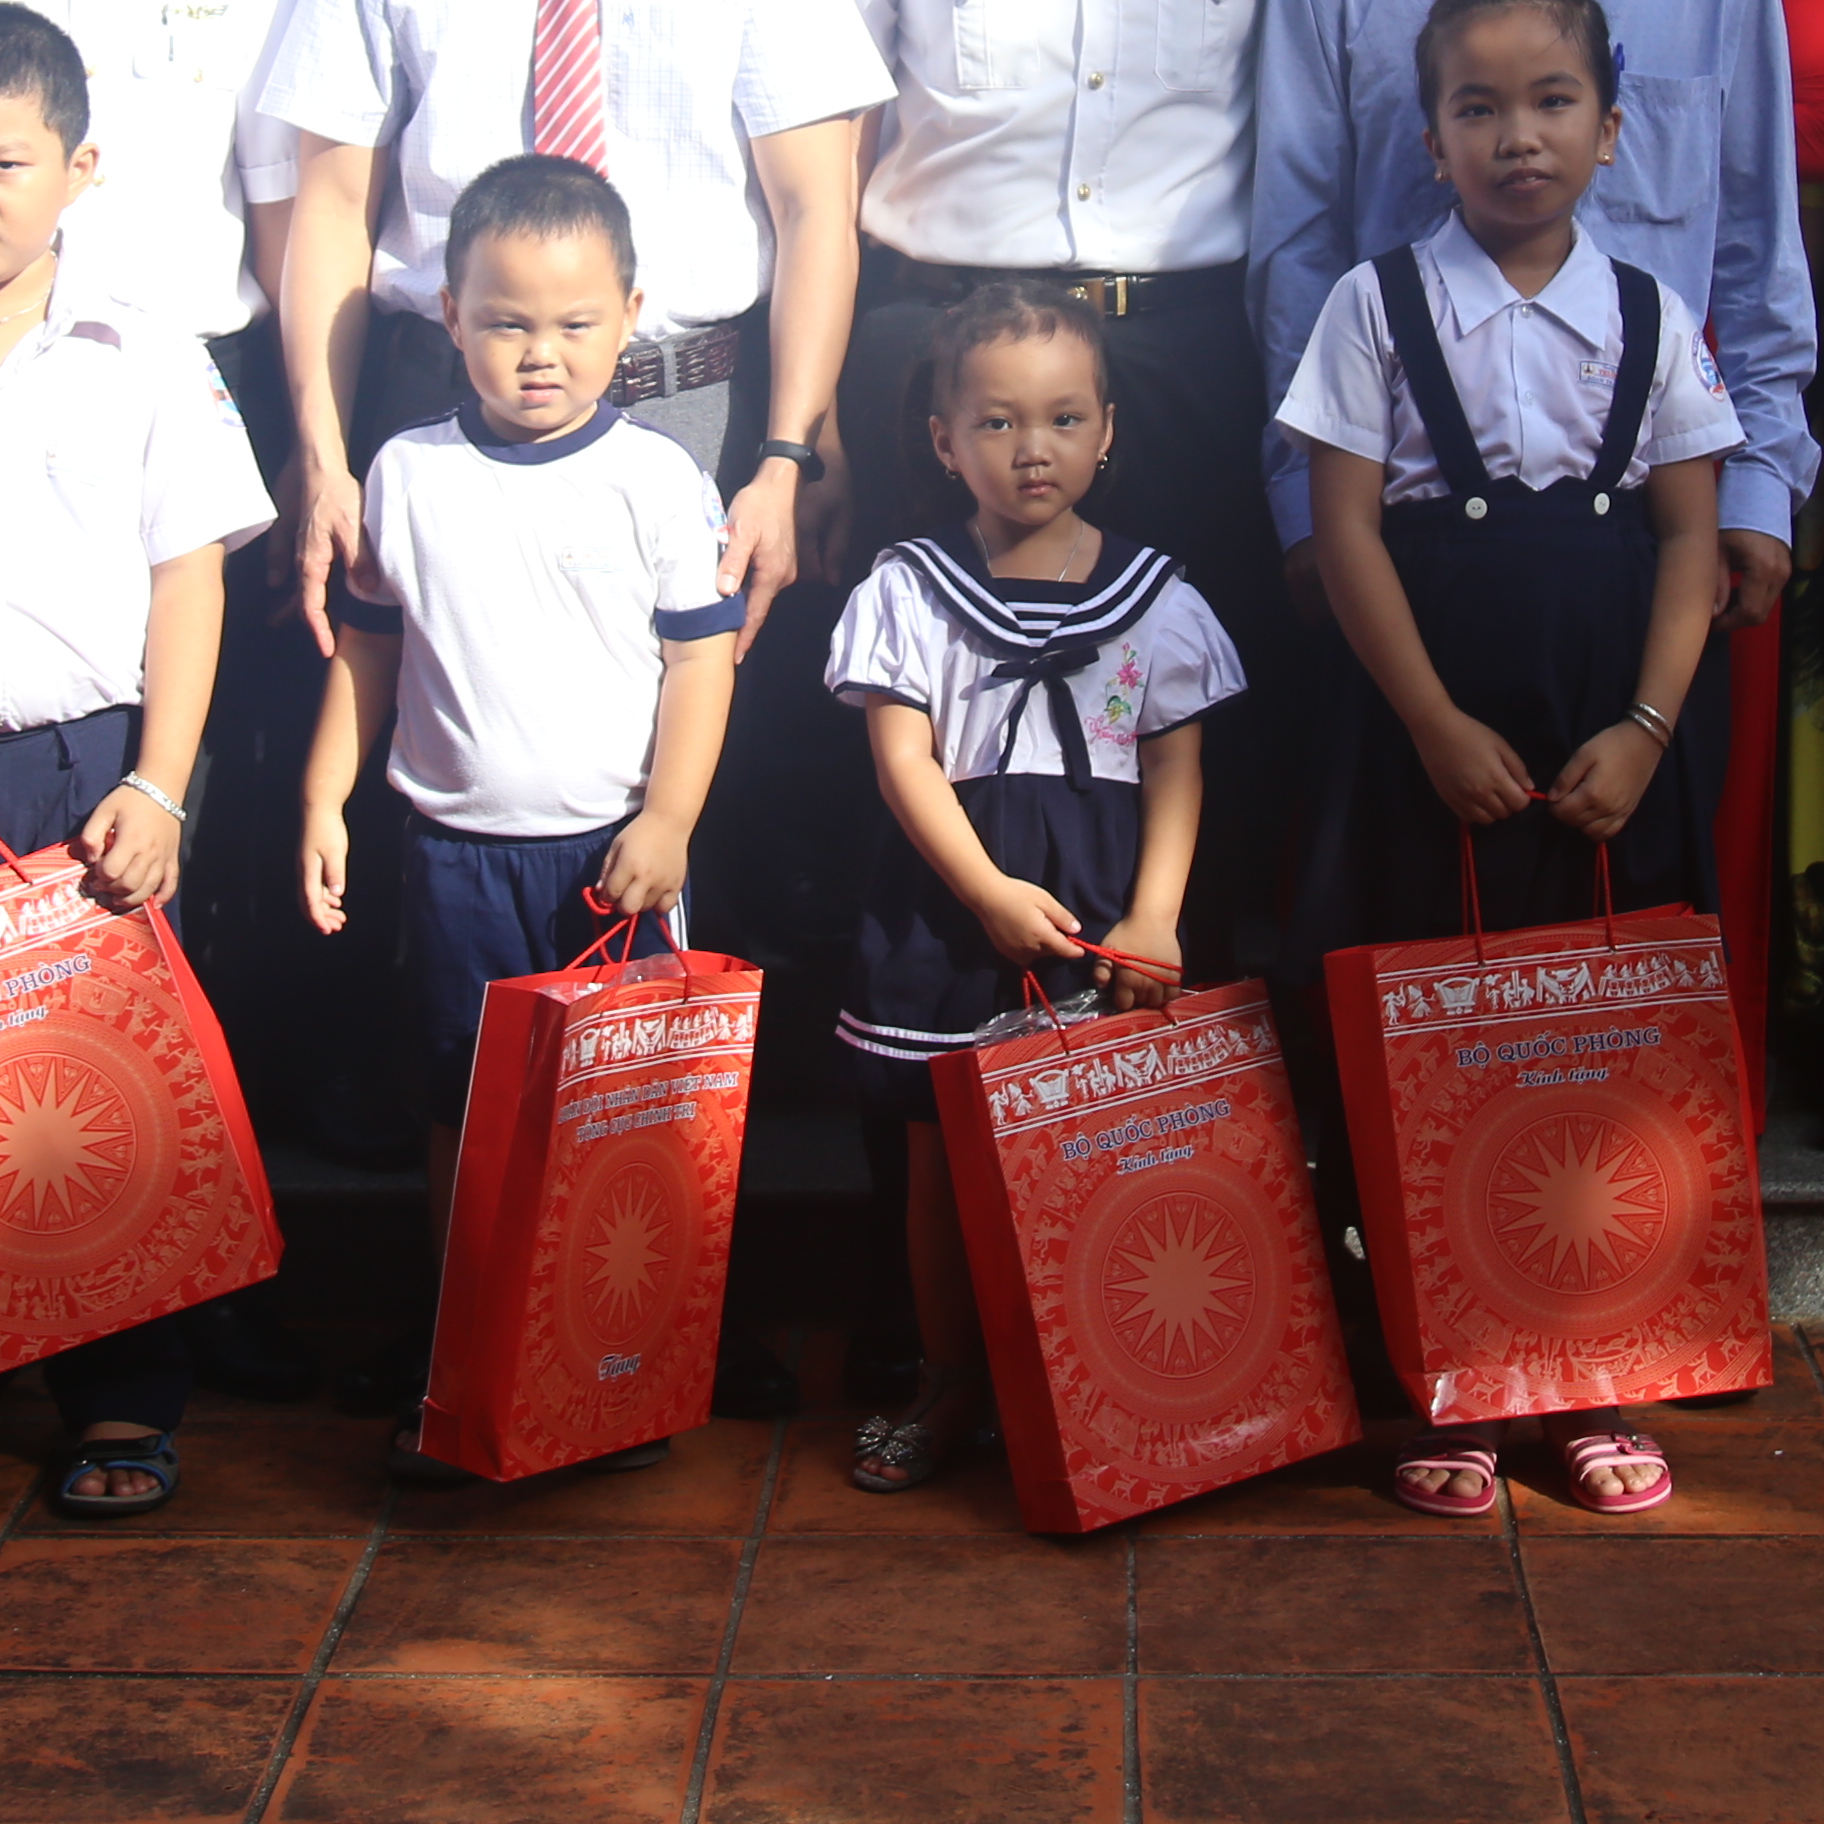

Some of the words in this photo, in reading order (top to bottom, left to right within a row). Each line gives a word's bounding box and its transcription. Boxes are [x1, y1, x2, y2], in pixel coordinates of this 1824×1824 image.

[5, 954, 92, 997] PHÒNG
[1457, 1041, 1491, 1068] BỘ
[1497, 1031, 1566, 1062] QUỐC
[1573, 1025, 1662, 1054] PHÒNG
[670, 1072, 702, 1095] VIỆT
[702, 1071, 739, 1090] NAM
[674, 1101, 697, 1121] TRỊ
[1062, 1133, 1091, 1160] BỘ
[1096, 1114, 1153, 1150] QUỐC
[1156, 1098, 1231, 1134] PHÒNG
